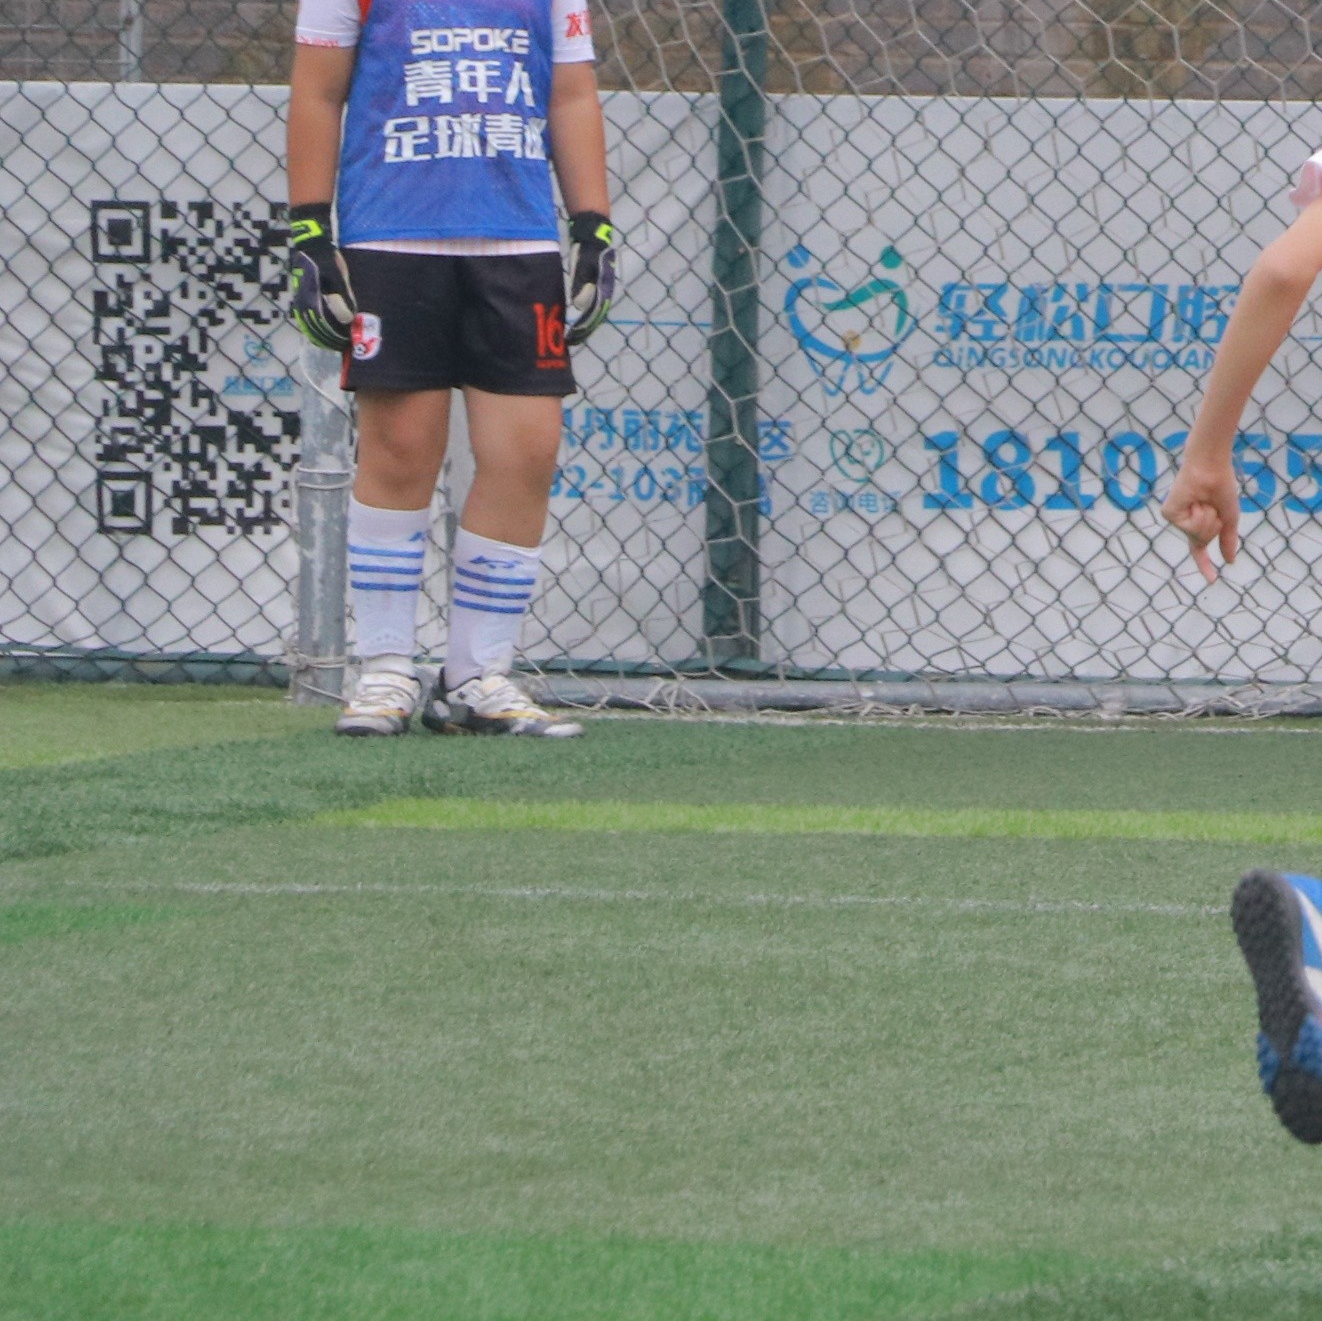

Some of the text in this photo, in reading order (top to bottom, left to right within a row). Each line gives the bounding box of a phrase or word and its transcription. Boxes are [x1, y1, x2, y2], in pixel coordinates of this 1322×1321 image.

[403, 59, 536, 107] 青年人
[533, 302, 565, 357] 16
